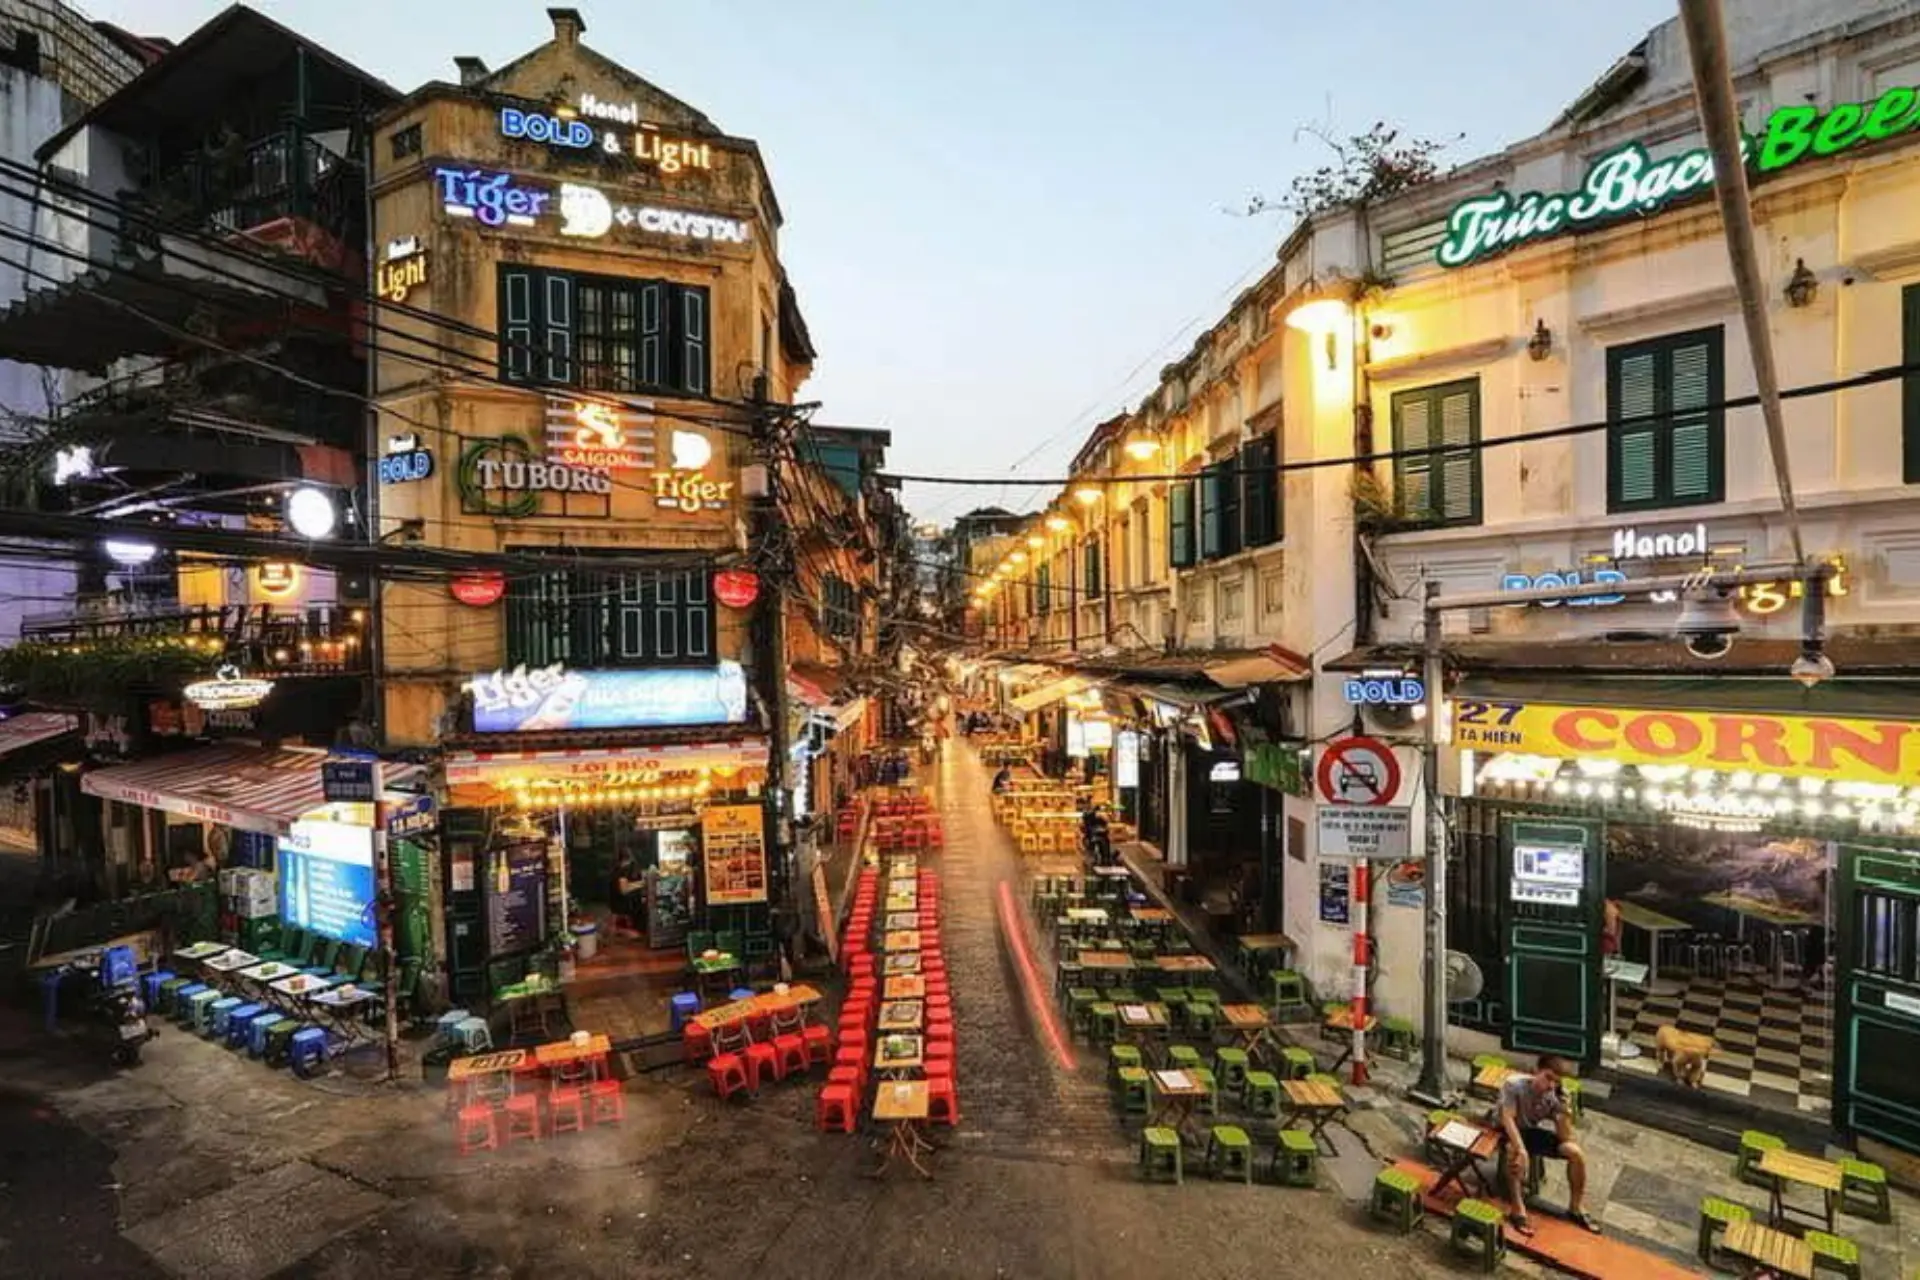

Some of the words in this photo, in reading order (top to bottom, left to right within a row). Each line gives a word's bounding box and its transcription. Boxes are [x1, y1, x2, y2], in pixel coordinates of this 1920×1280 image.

[501, 108, 593, 148] BOLD
[603, 132, 621, 154] &
[634, 132, 711, 173] Light
[1442, 196, 1561, 264] Trúc
[1759, 86, 1920, 170] Bee
[435, 168, 549, 226] Tiger
[377, 256, 426, 302] Light
[378, 452, 430, 483] BOLD
[477, 459, 611, 494] TUBORG
[563, 449, 635, 468] SAIGON
[650, 472, 735, 513] Tiger
[1344, 680, 1425, 704] BOLD
[1458, 701, 1523, 725] 27
[1459, 727, 1479, 742] TA
[1482, 730, 1523, 745] HIEN
[1552, 709, 1920, 776] CORN
